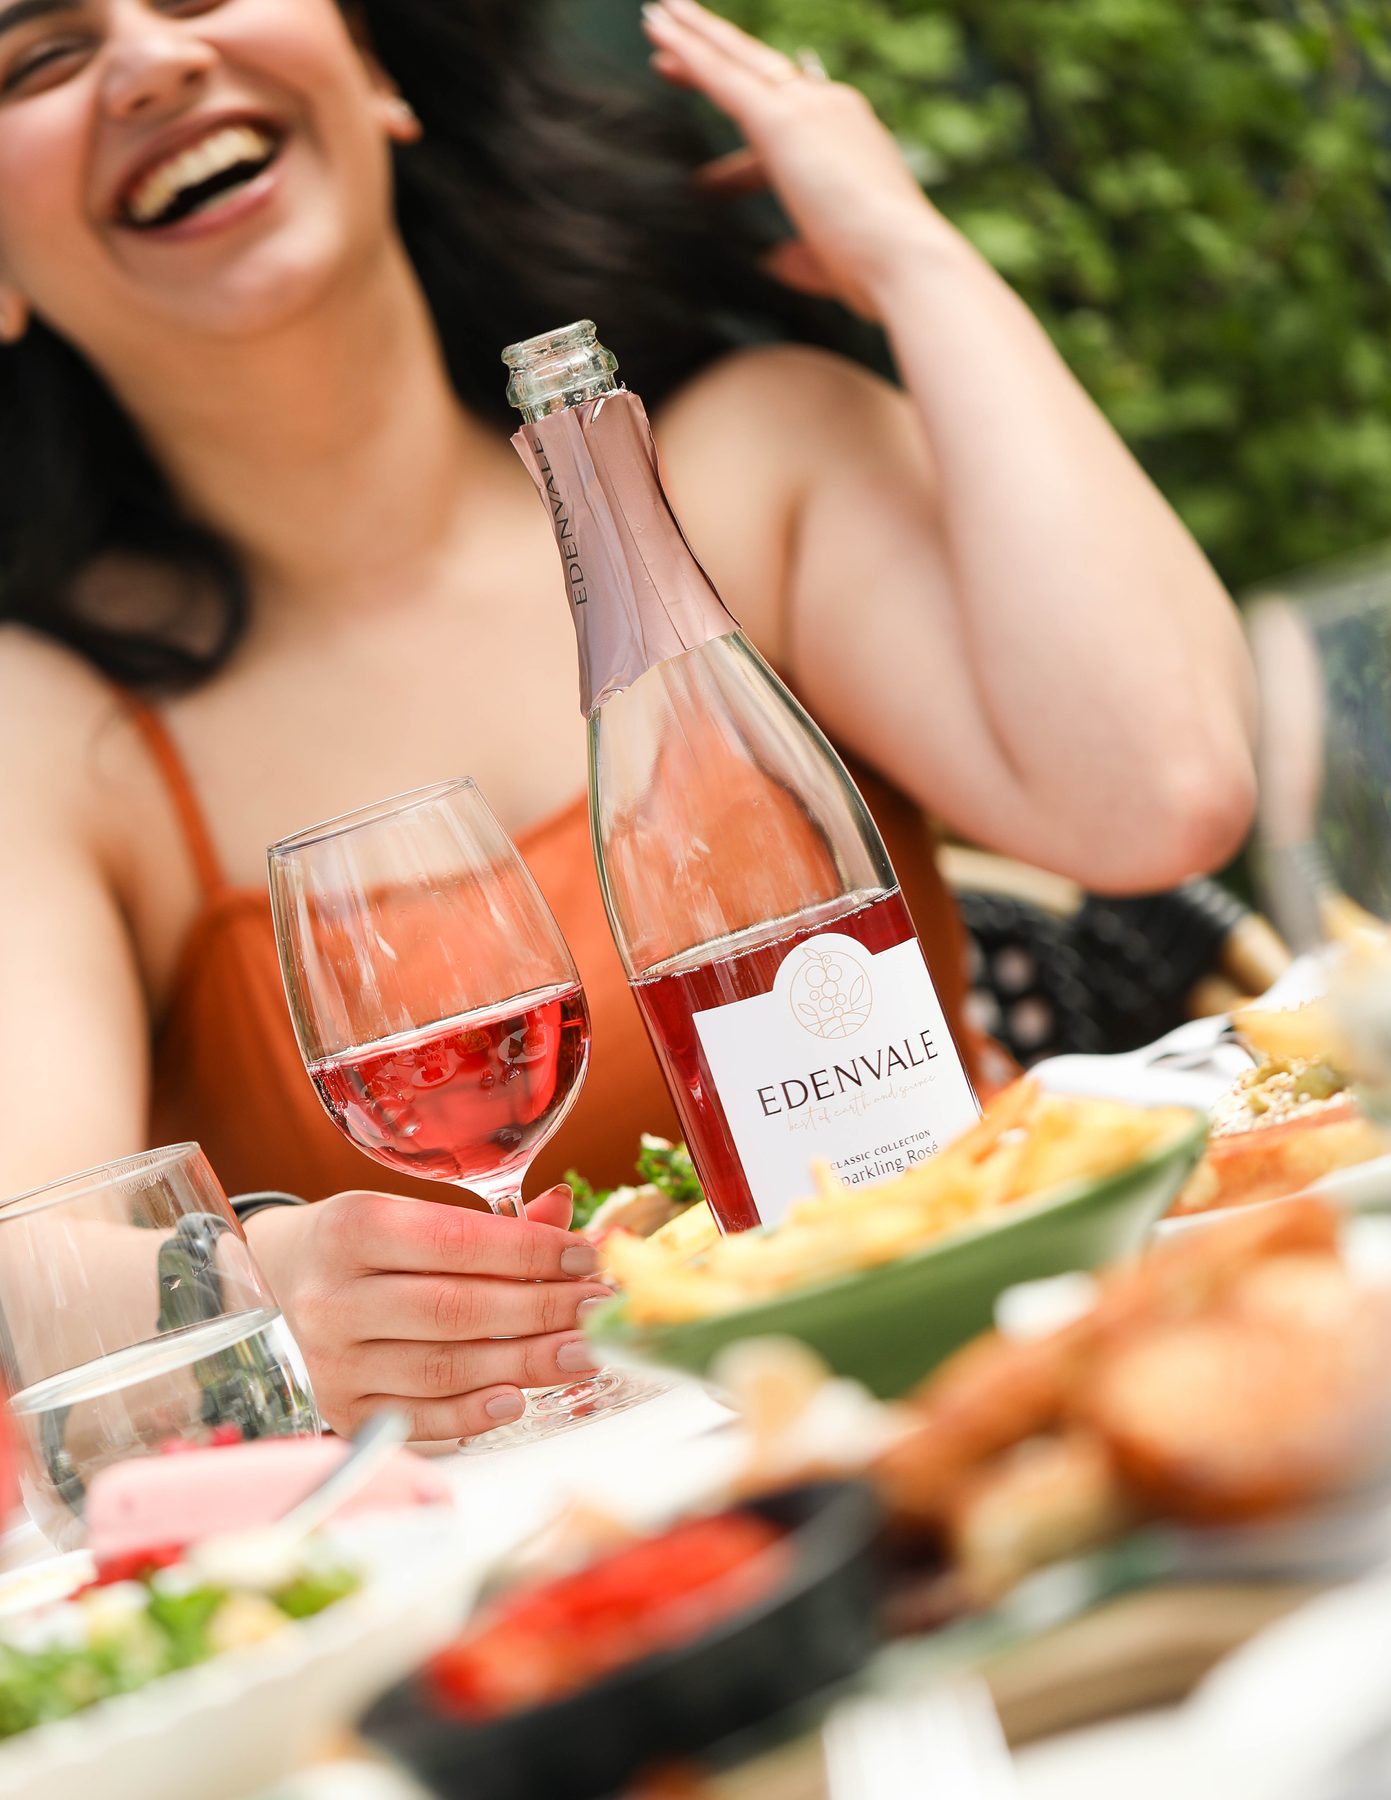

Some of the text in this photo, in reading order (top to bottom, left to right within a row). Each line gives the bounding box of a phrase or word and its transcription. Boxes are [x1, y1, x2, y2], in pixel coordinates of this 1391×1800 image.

[533, 437, 588, 605] EDENVALE
[756, 1030, 938, 1116] EDENVALE
[830, 1129, 931, 1170] CLASSIC COLLECTION
[834, 1140, 940, 1187] parkling Rosé
